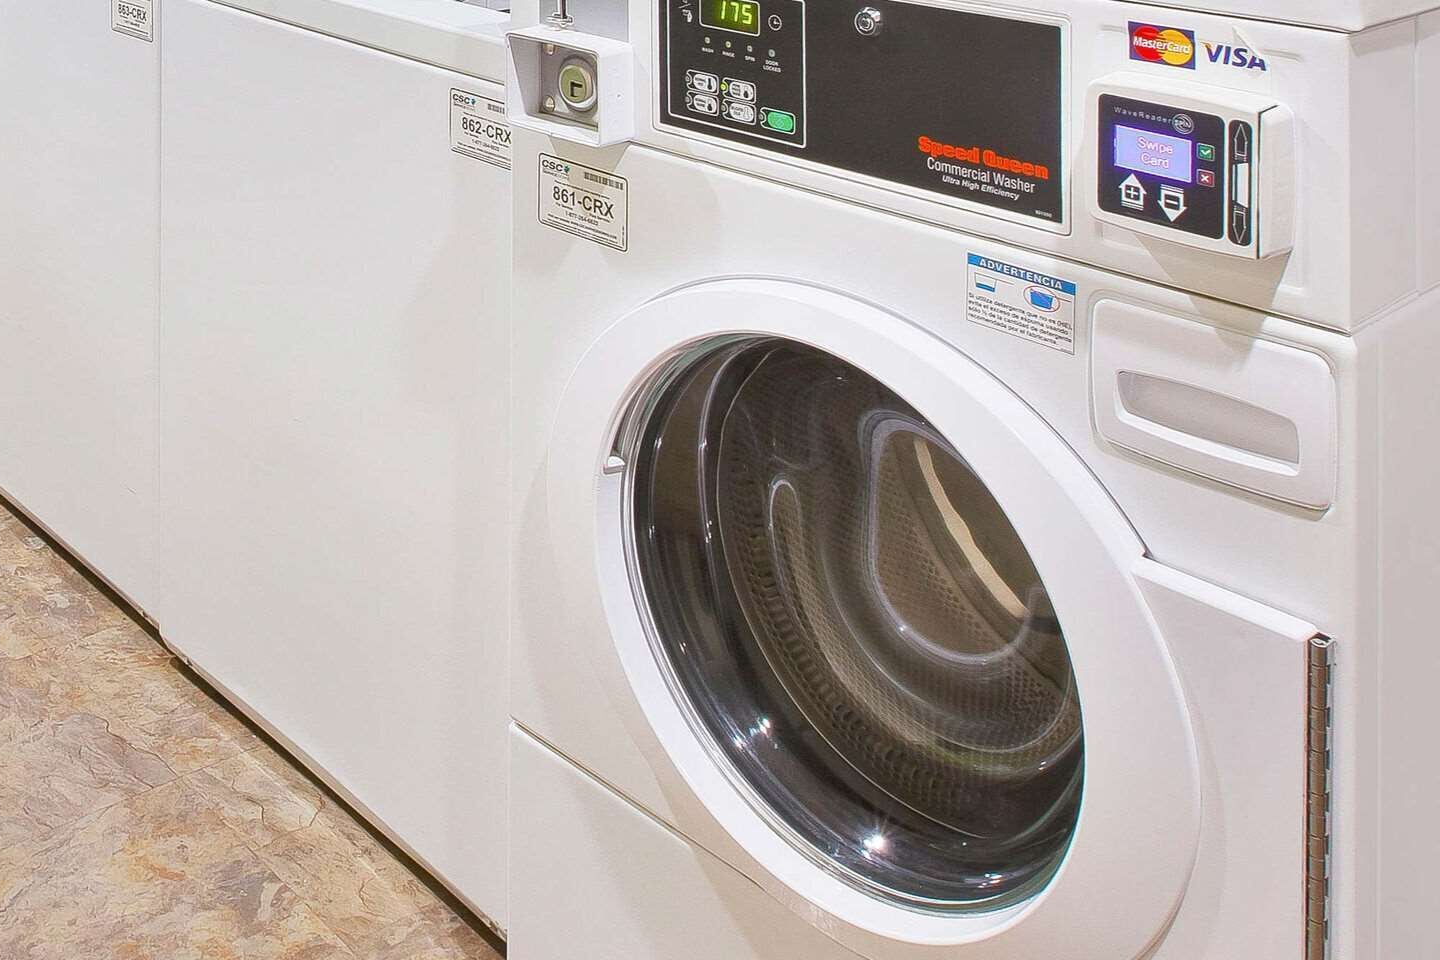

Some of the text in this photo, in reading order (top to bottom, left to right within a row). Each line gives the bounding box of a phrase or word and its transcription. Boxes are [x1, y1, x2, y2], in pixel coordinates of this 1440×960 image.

[720, 0, 752, 25] 175
[1133, 35, 1191, 55] MasterCard
[1201, 41, 1267, 71] VISA
[452, 94, 470, 104] CSC
[1113, 106, 1172, 123] WaveReader
[462, 117, 511, 144] 862-CRX
[918, 135, 1049, 180] Speed Queen
[1137, 136, 1173, 154] Swipe
[542, 159, 563, 172] CSC
[1141, 152, 1170, 169] Card
[926, 156, 1036, 194] Commercial Washer
[942, 174, 1020, 201] Ultra High Efficiency
[553, 185, 614, 219] 861-CRX
[979, 258, 1063, 290] ADVERTENCIA
[993, 301, 1025, 314] detergente
